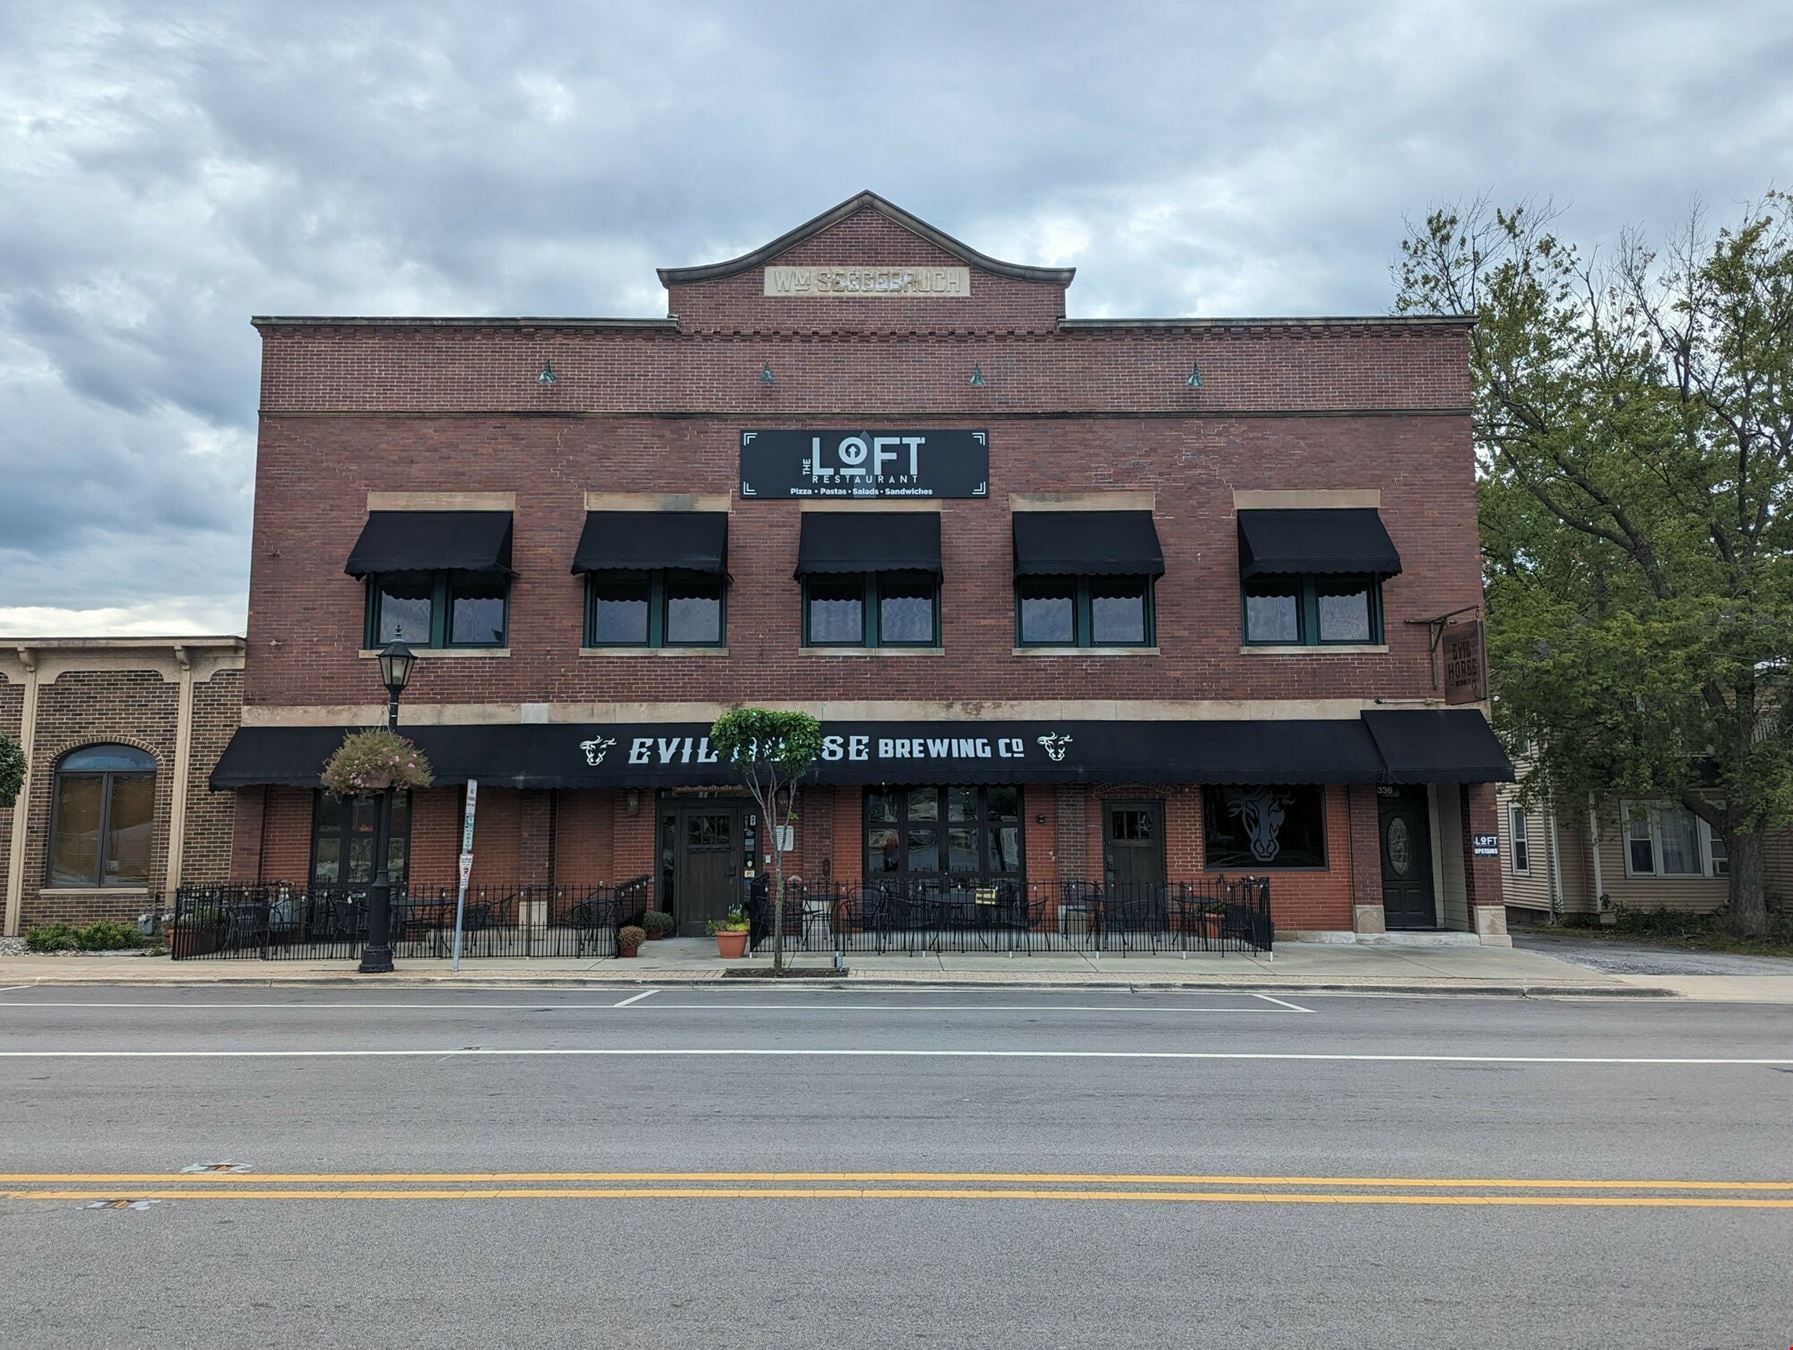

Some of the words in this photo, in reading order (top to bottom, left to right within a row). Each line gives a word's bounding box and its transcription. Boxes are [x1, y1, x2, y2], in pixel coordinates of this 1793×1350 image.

[802, 458, 811, 476] THE
[812, 436, 926, 476] LOFT
[812, 475, 919, 484] RESTAURANT
[790, 487, 813, 496] Pizza
[820, 487, 847, 496] Pastas
[852, 487, 879, 496] Salads
[884, 487, 933, 496] Sandwiches
[628, 737, 719, 764] EVIL
[878, 738, 992, 758] BREWING
[1475, 836, 1497, 845] LOFT
